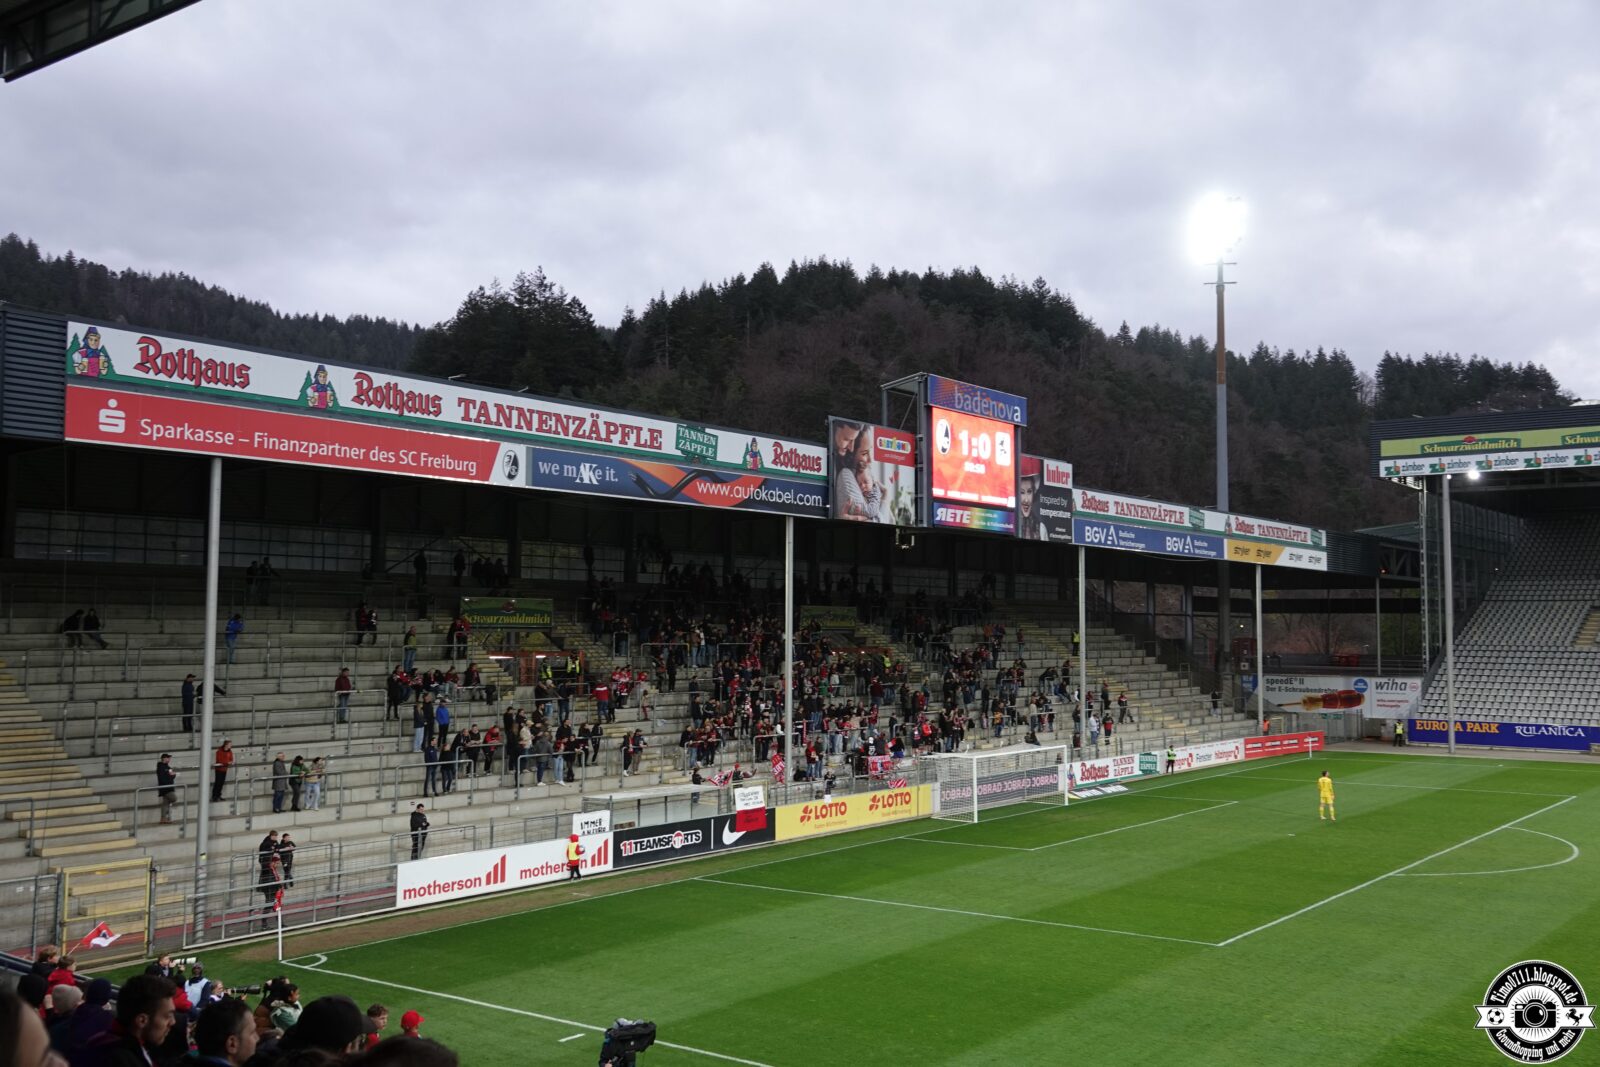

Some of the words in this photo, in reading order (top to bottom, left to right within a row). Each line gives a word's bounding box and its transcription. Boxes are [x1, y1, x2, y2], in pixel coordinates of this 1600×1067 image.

[134, 336, 251, 389] Rothaus
[351, 371, 443, 417] Rothaus
[457, 396, 663, 451] TANNENZÄPFLE
[954, 384, 1021, 422] badenova
[678, 427, 716, 446] TANNEN
[959, 430, 991, 459] 1:0
[1423, 439, 1518, 454] Schwarzwaldmilch
[140, 419, 234, 449] Sparkasse
[254, 432, 366, 460] Finanzpartner
[370, 446, 396, 462] des
[399, 450, 418, 466] SC
[420, 454, 478, 475] Freiburg
[678, 439, 715, 457] ZÄPFLE
[772, 441, 823, 473] Rothaus
[538, 462, 560, 476] we
[1046, 464, 1070, 485] huber
[696, 481, 822, 506] www.autokabel.com
[1081, 491, 1109, 514] Rothaus
[1113, 501, 1185, 525] TANNENZÄPFLE
[1375, 678, 1408, 691] wiha
[1415, 720, 1463, 733] EUROA
[1466, 722, 1499, 734] PARK
[1515, 724, 1585, 738] RULANTICA
[1113, 756, 1135, 766] TANNEN
[1080, 762, 1109, 782] Rothaus
[978, 784, 1002, 796] OBRAD
[1032, 774, 1058, 787] JOBRAD
[882, 792, 911, 808] LOTTO
[814, 801, 847, 820] LOTTO
[580, 818, 602, 830] IMMER
[403, 876, 482, 900] motherson
[520, 858, 587, 881] mothersn
